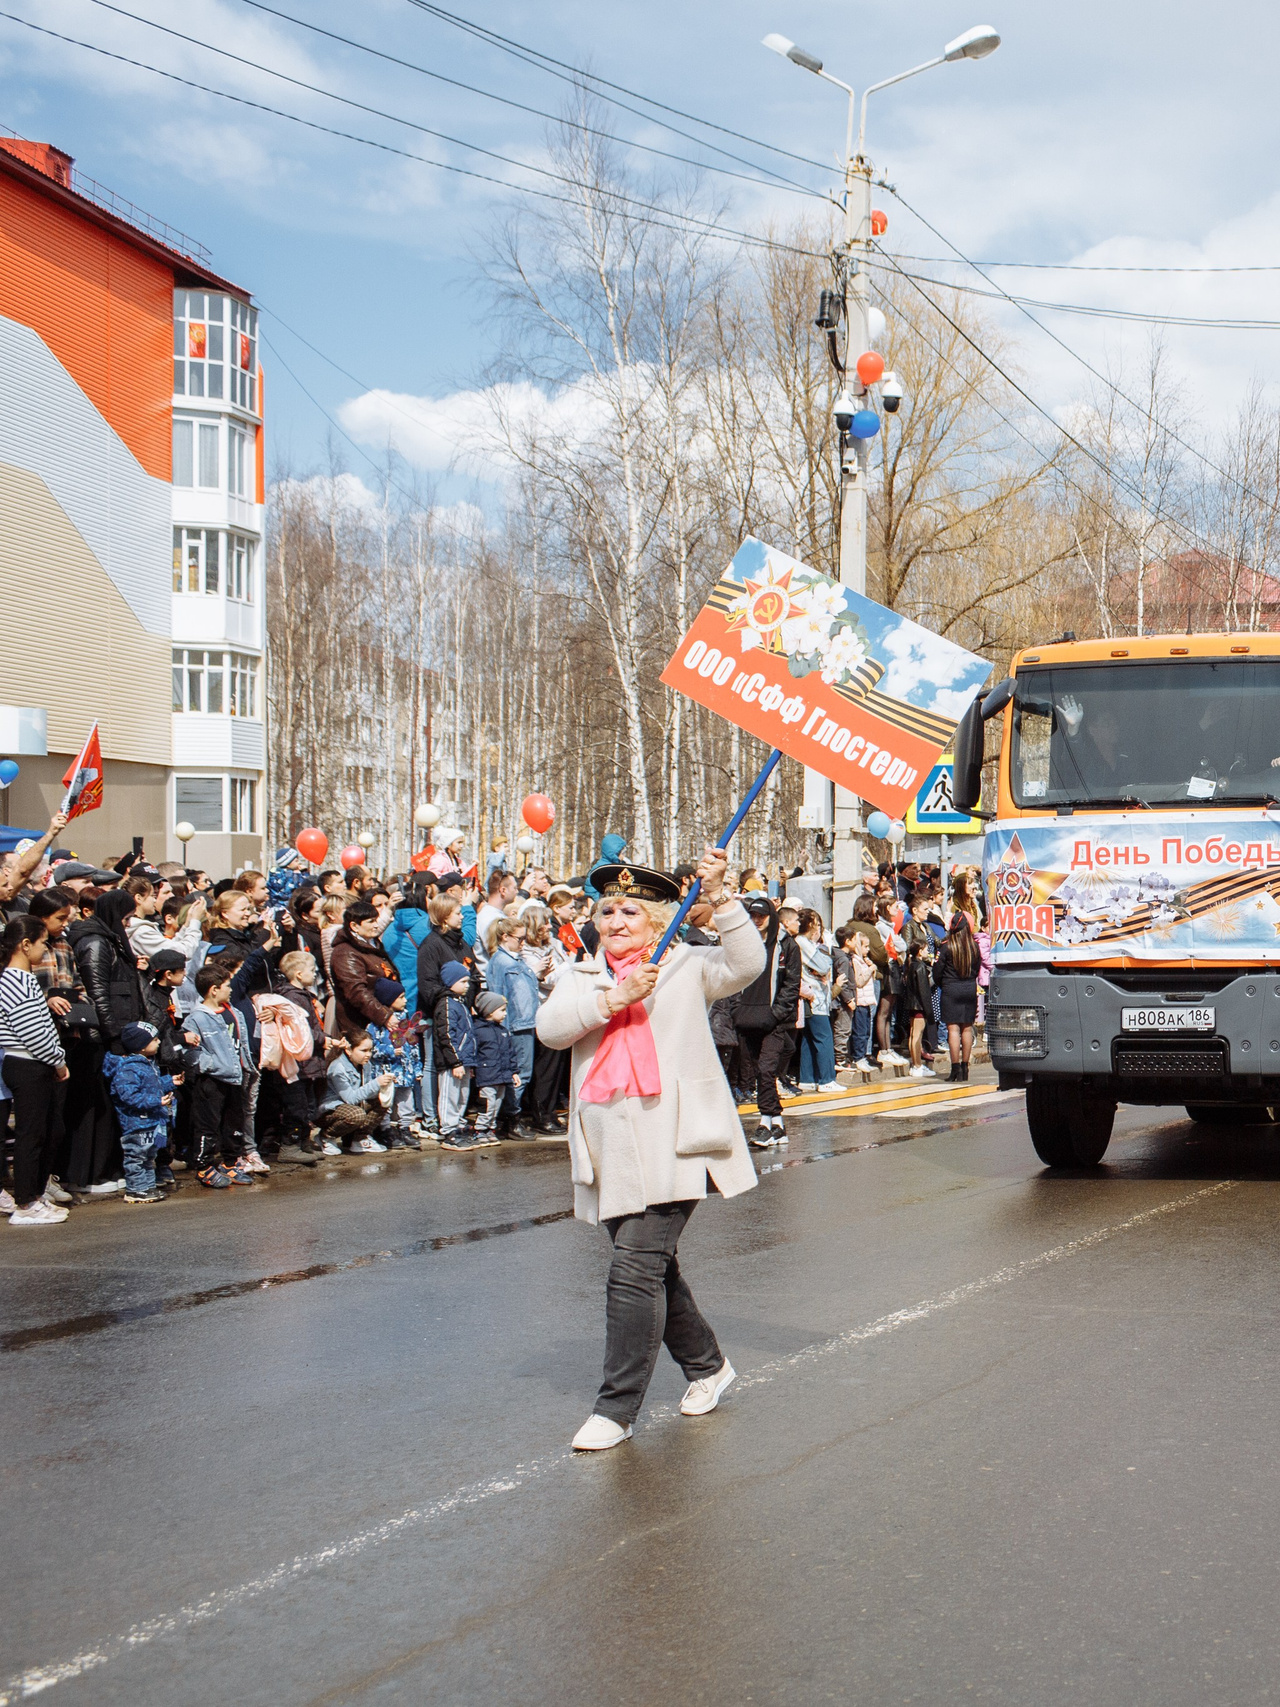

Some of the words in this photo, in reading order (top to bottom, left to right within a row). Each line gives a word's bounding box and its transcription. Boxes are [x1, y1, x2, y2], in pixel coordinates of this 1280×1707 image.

[683, 640, 737, 686] ООО
[801, 706, 918, 790] Глостер»
[1070, 840, 1150, 871] День
[994, 905, 1054, 940] мая
[1188, 1009, 1210, 1021] 186
